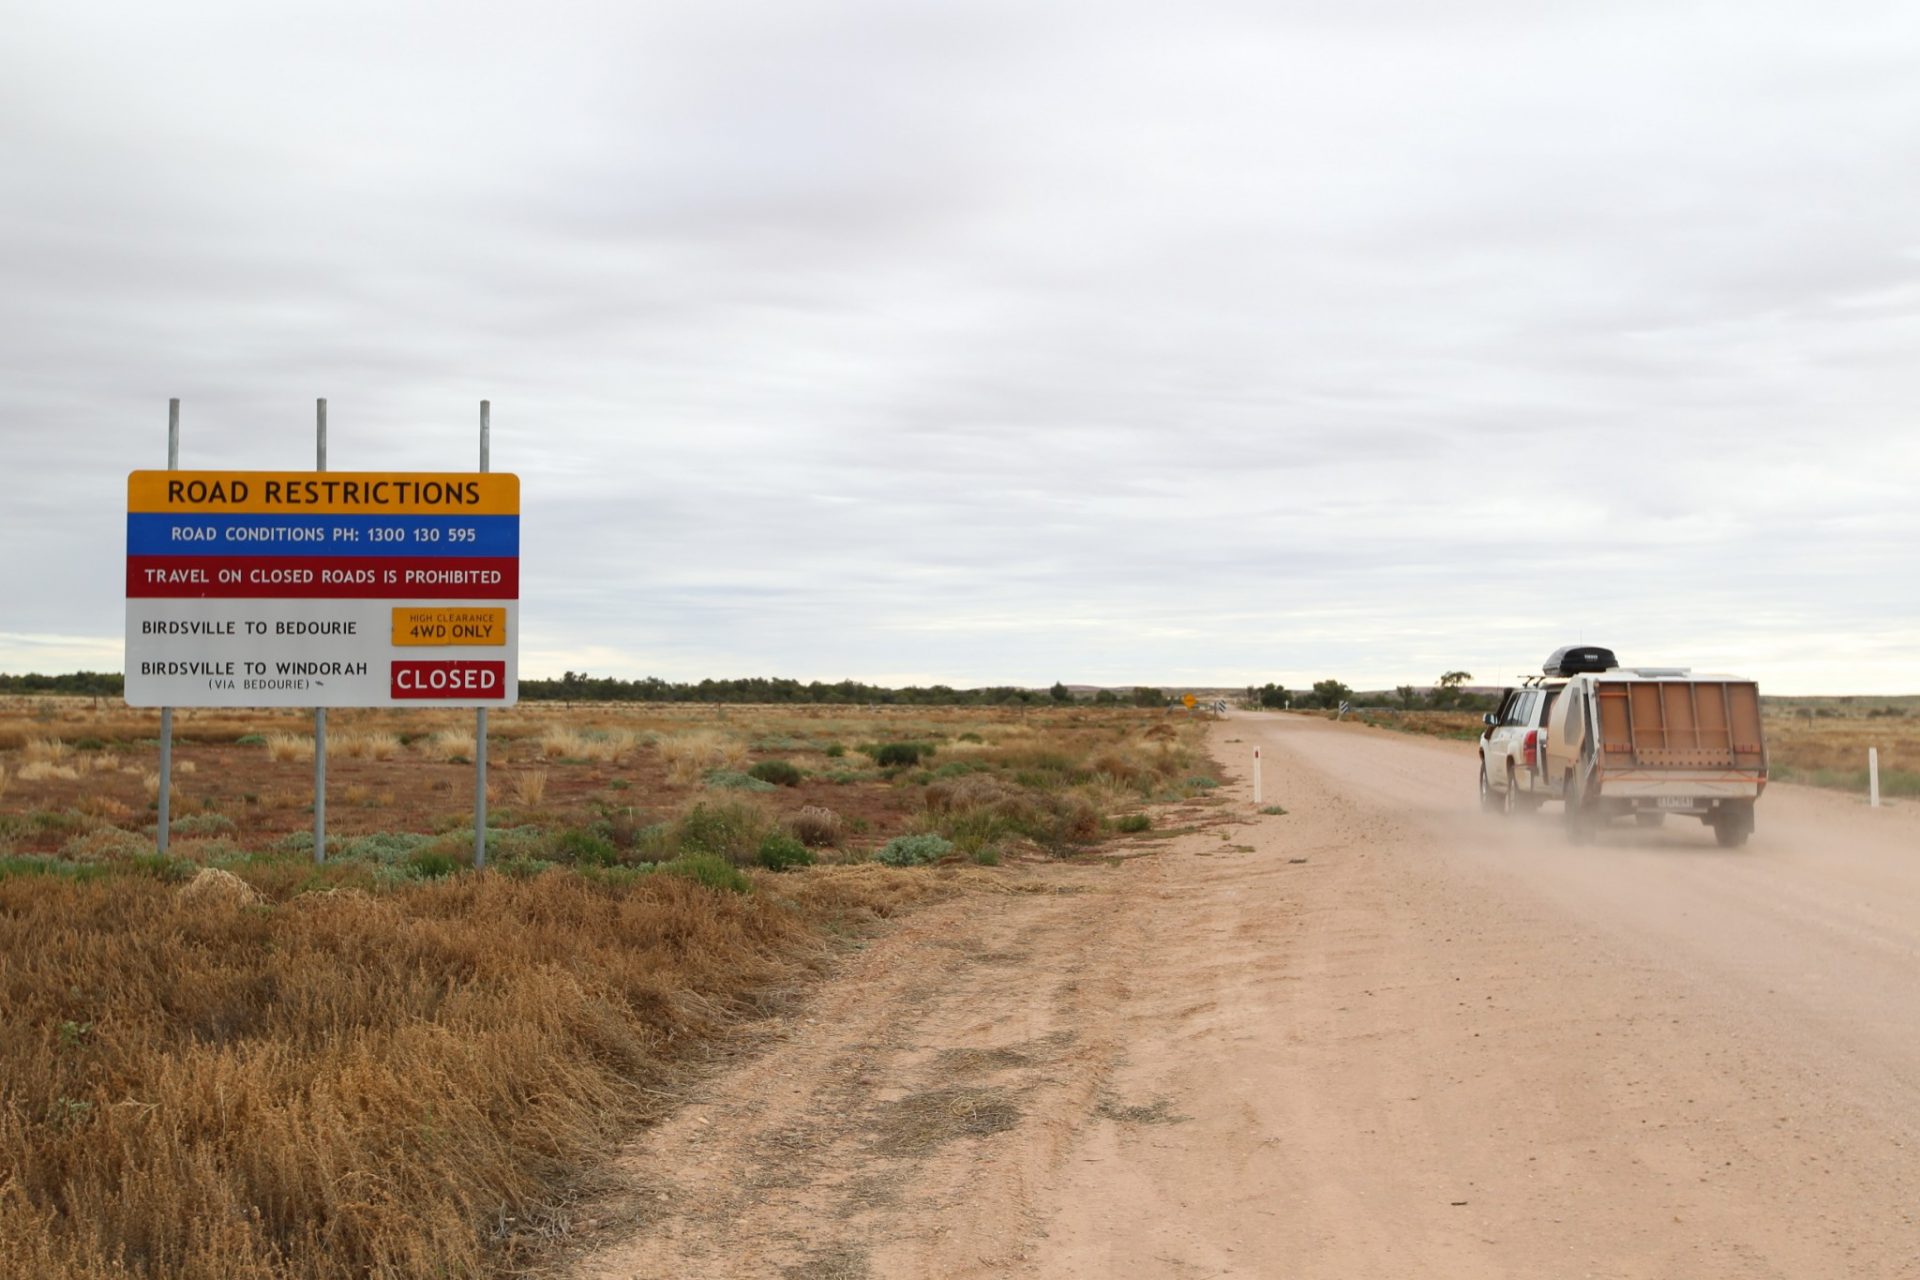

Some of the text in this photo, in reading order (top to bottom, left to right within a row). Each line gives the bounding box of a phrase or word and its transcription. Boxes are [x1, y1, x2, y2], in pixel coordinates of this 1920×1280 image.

[168, 480, 480, 504] ROAD RESTRICTIONS
[171, 528, 475, 542] ROAD CONDITIONS PH: 1300 130 595
[145, 569, 501, 584] TRAVEL ON CLOSED ROADS IS PROHIBITED
[410, 614, 494, 622] HIGH CLEARANCE
[142, 622, 357, 634] BIRDSVILLE TO BEDOURIE
[410, 625, 492, 638] 4WD ONLY
[141, 662, 367, 675] BIRDSVILLE TO WINDORAH
[208, 679, 310, 690] (VIA BEDOURIE)
[397, 670, 495, 689] CLOSED
